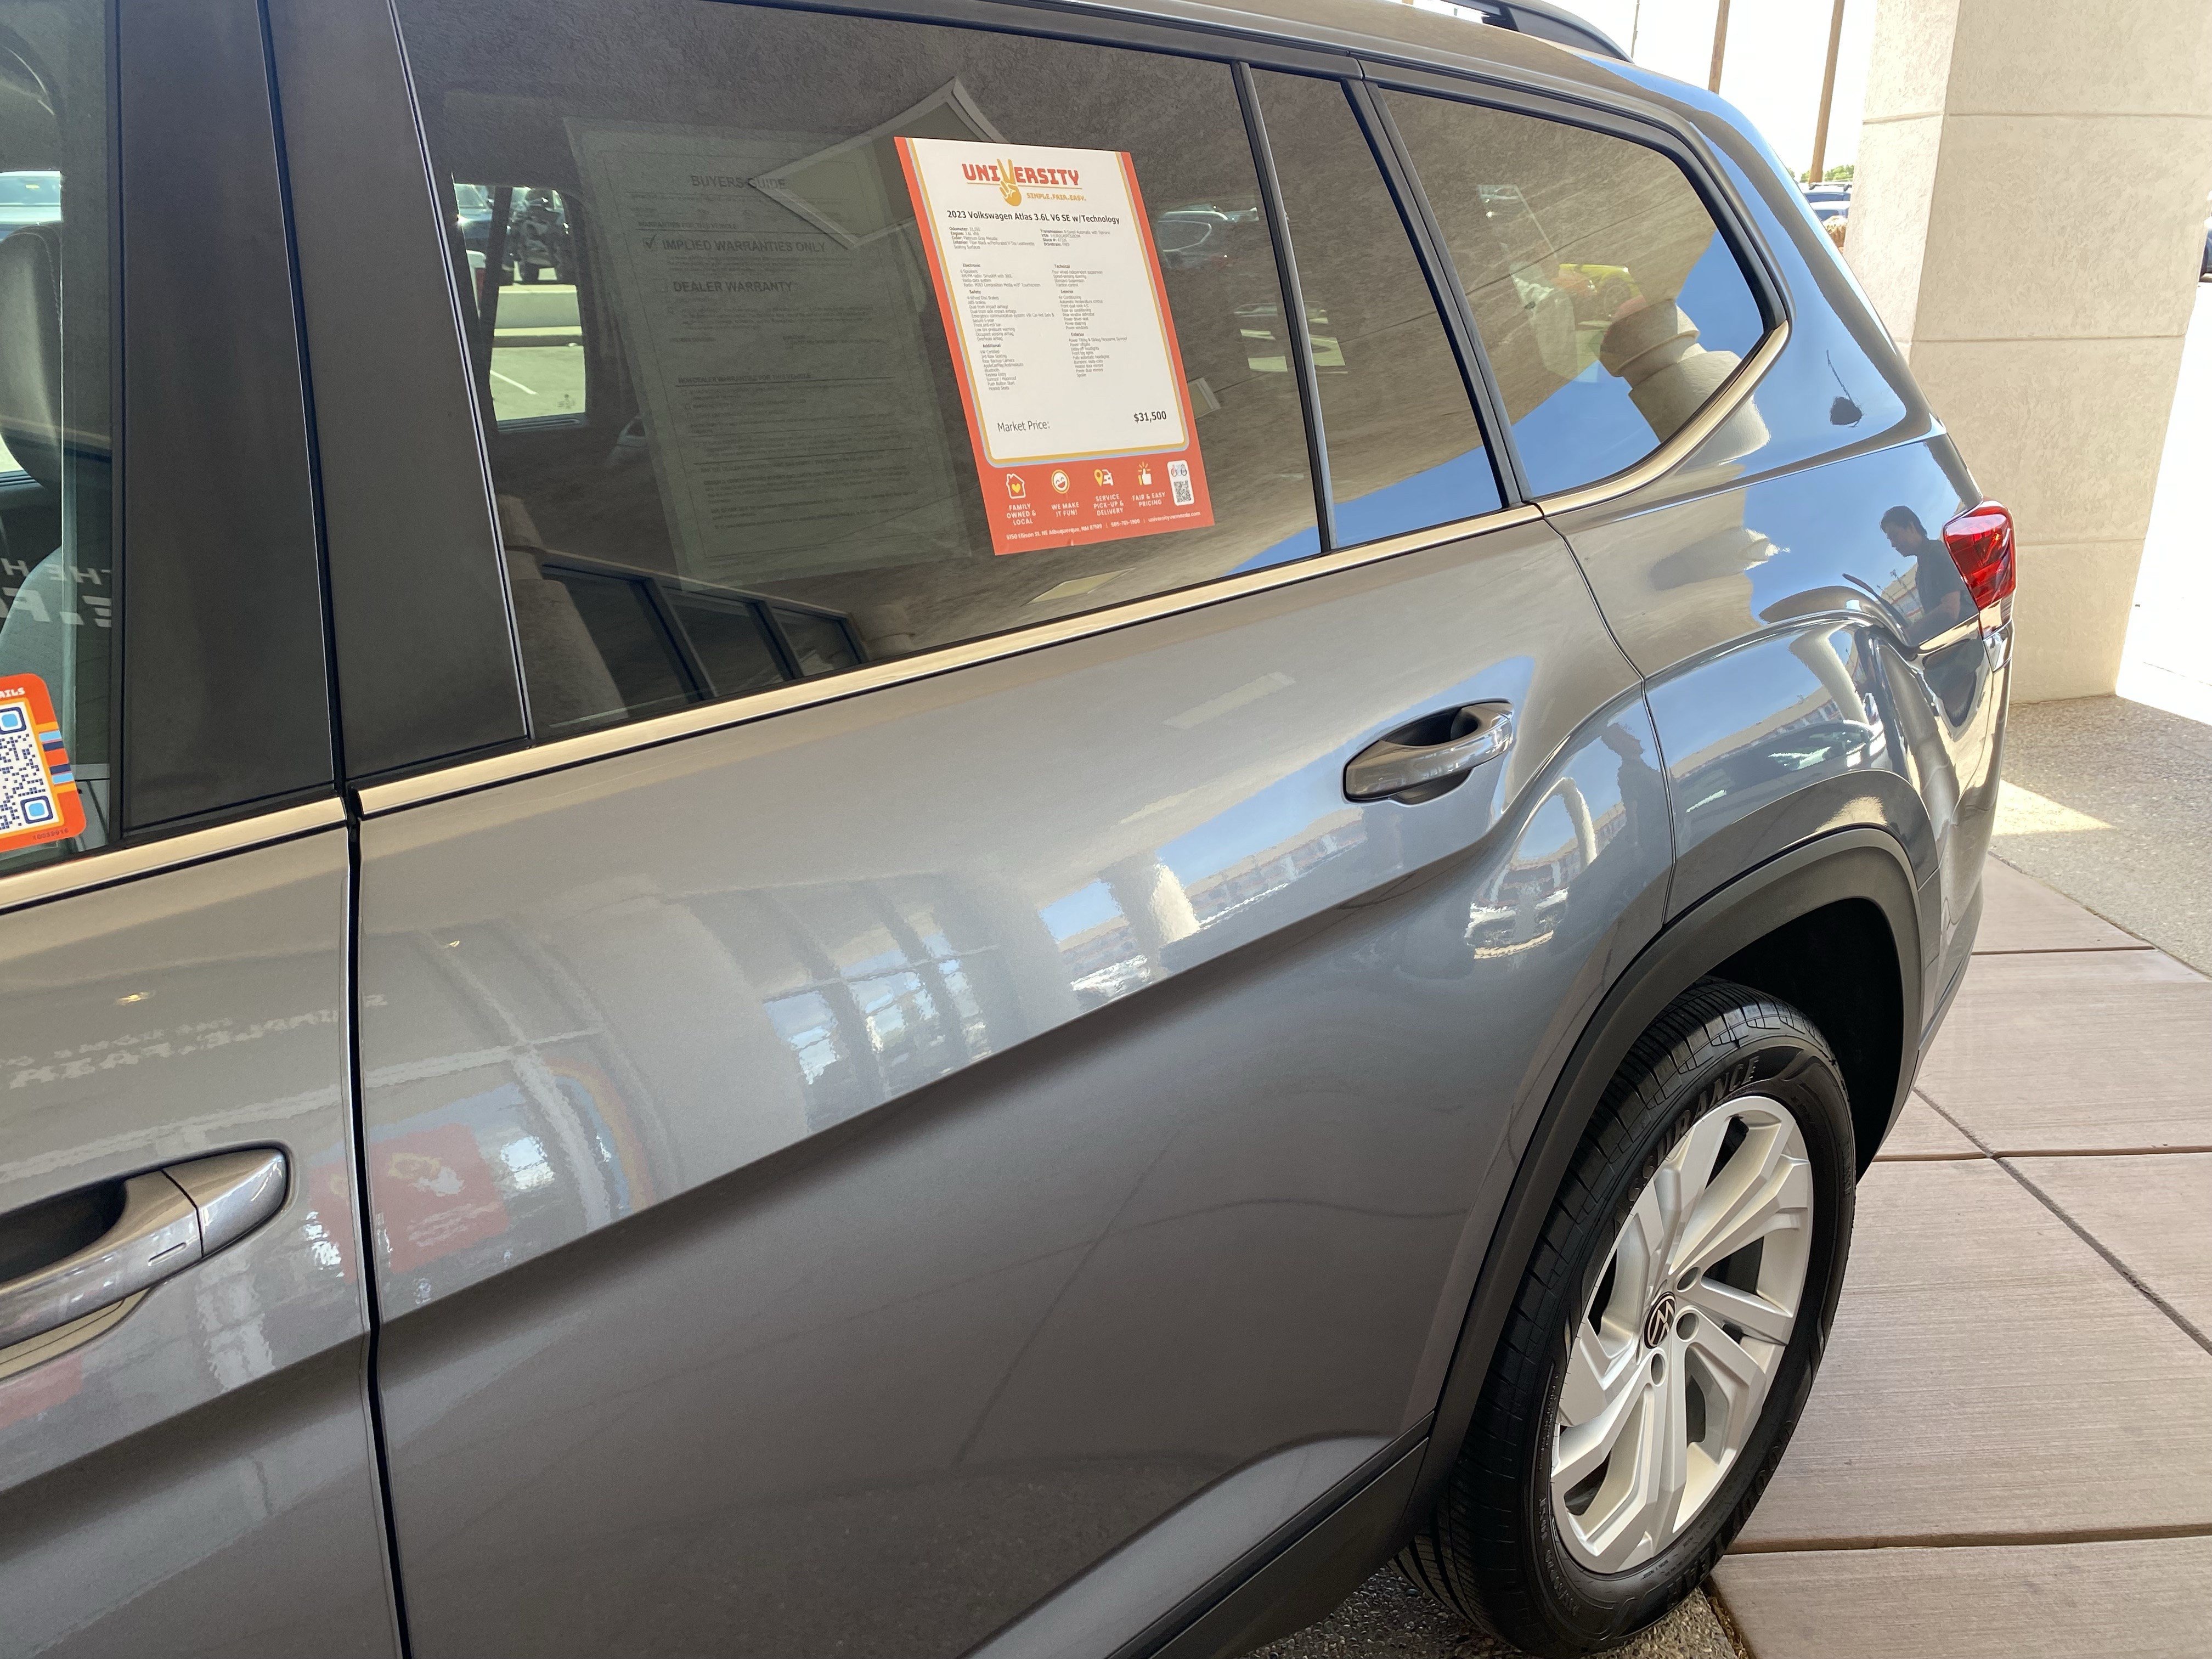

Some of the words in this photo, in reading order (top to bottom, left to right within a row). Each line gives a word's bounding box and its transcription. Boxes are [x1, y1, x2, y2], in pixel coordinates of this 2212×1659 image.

[962, 159, 1079, 185] UNIVERSITY
[691, 174, 744, 189] BUYERS
[749, 177, 785, 189] GUIDE
[947, 210, 966, 218] 2023
[968, 211, 1012, 221] Volkswagen
[1015, 212, 1032, 221] Atlas
[1072, 215, 1120, 224] w/Technology
[662, 239, 712, 251] IMPLIED
[715, 240, 793, 252] WARRANTIES
[795, 242, 825, 252] ONLY
[673, 281, 722, 292] DEALER
[726, 281, 792, 292] WARRANTY
[997, 421, 1025, 432] Market
[1028, 420, 1050, 430] Price:
[1133, 411, 1166, 423] $31,500
